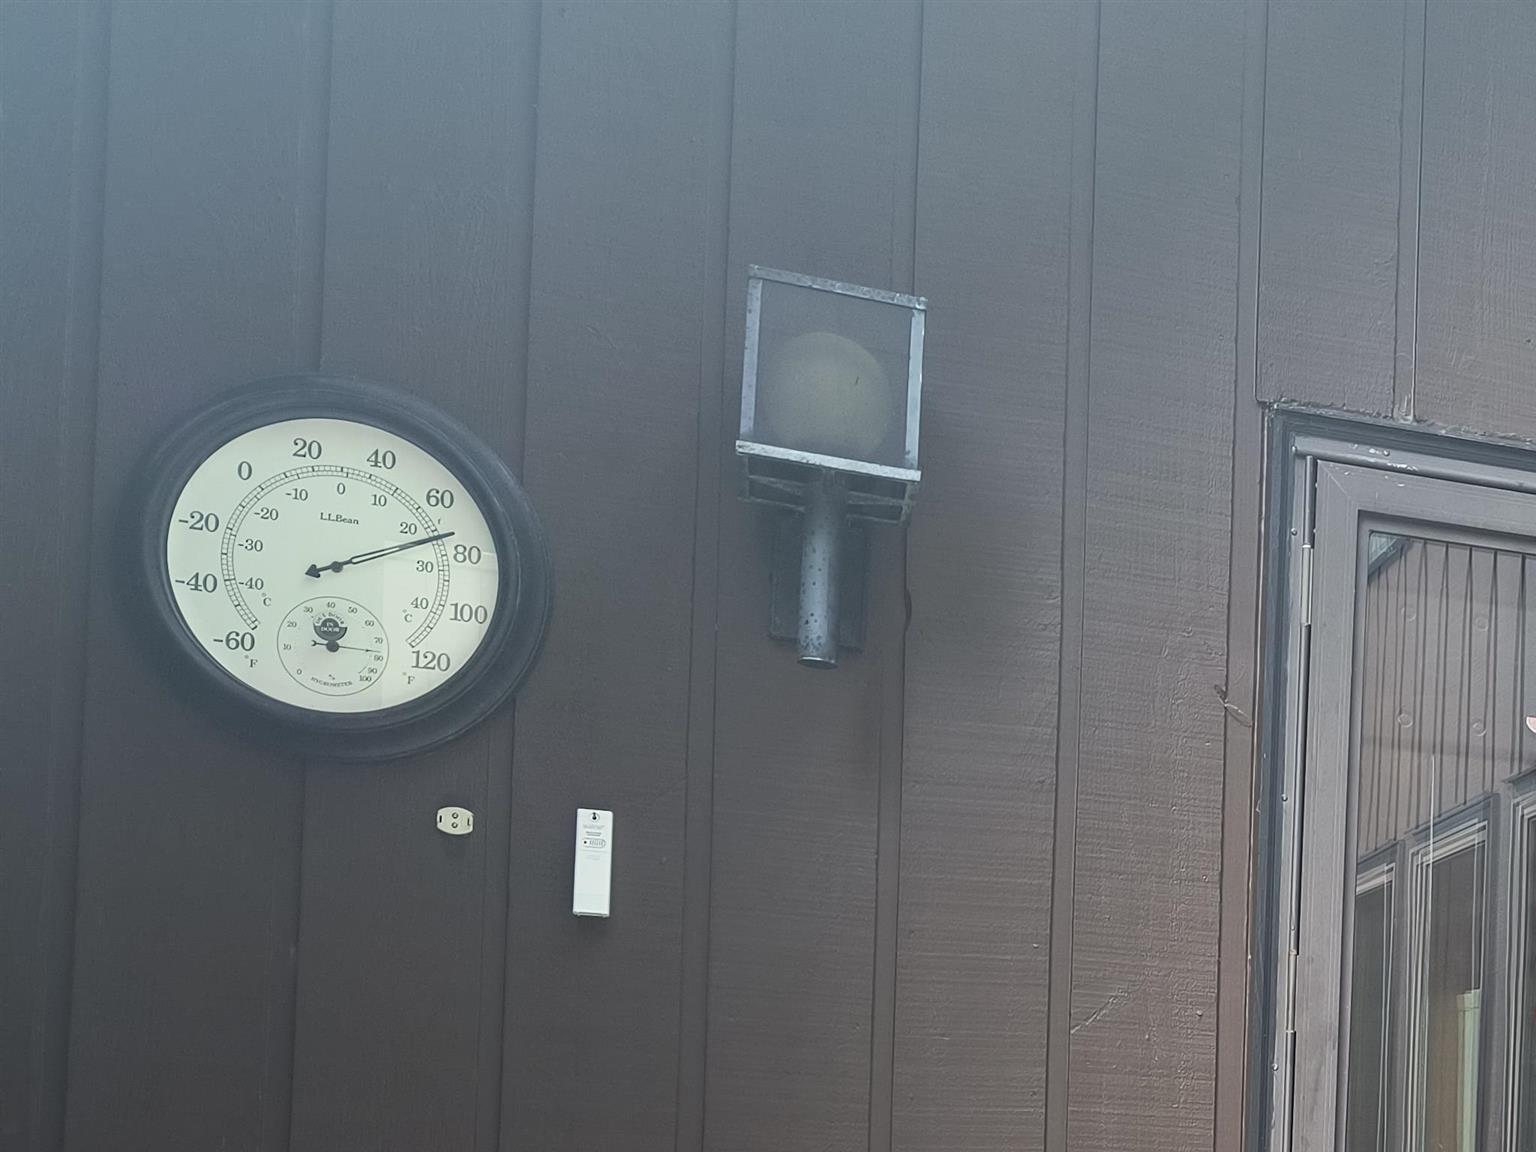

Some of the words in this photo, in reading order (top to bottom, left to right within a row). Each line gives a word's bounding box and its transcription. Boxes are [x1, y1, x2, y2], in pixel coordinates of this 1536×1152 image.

[292, 437, 322, 460] 20
[366, 448, 396, 470] 40
[237, 460, 253, 480] 0
[285, 488, 309, 501] -10
[336, 482, 346, 495] 0
[371, 494, 387, 507] 10
[425, 488, 455, 509] 60
[253, 506, 279, 521] -20
[178, 510, 220, 533] -20
[399, 521, 417, 535] 20
[237, 538, 264, 552] -30
[453, 544, 482, 565] 80
[416, 560, 434, 573] 30
[175, 571, 218, 593] -40
[238, 577, 264, 590] -40
[347, 606, 358, 614] 50
[410, 596, 429, 610] 40
[449, 602, 488, 624] 100
[286, 620, 297, 628] 20
[364, 619, 375, 628] 60
[213, 630, 255, 652] -60
[411, 650, 451, 672] 120
